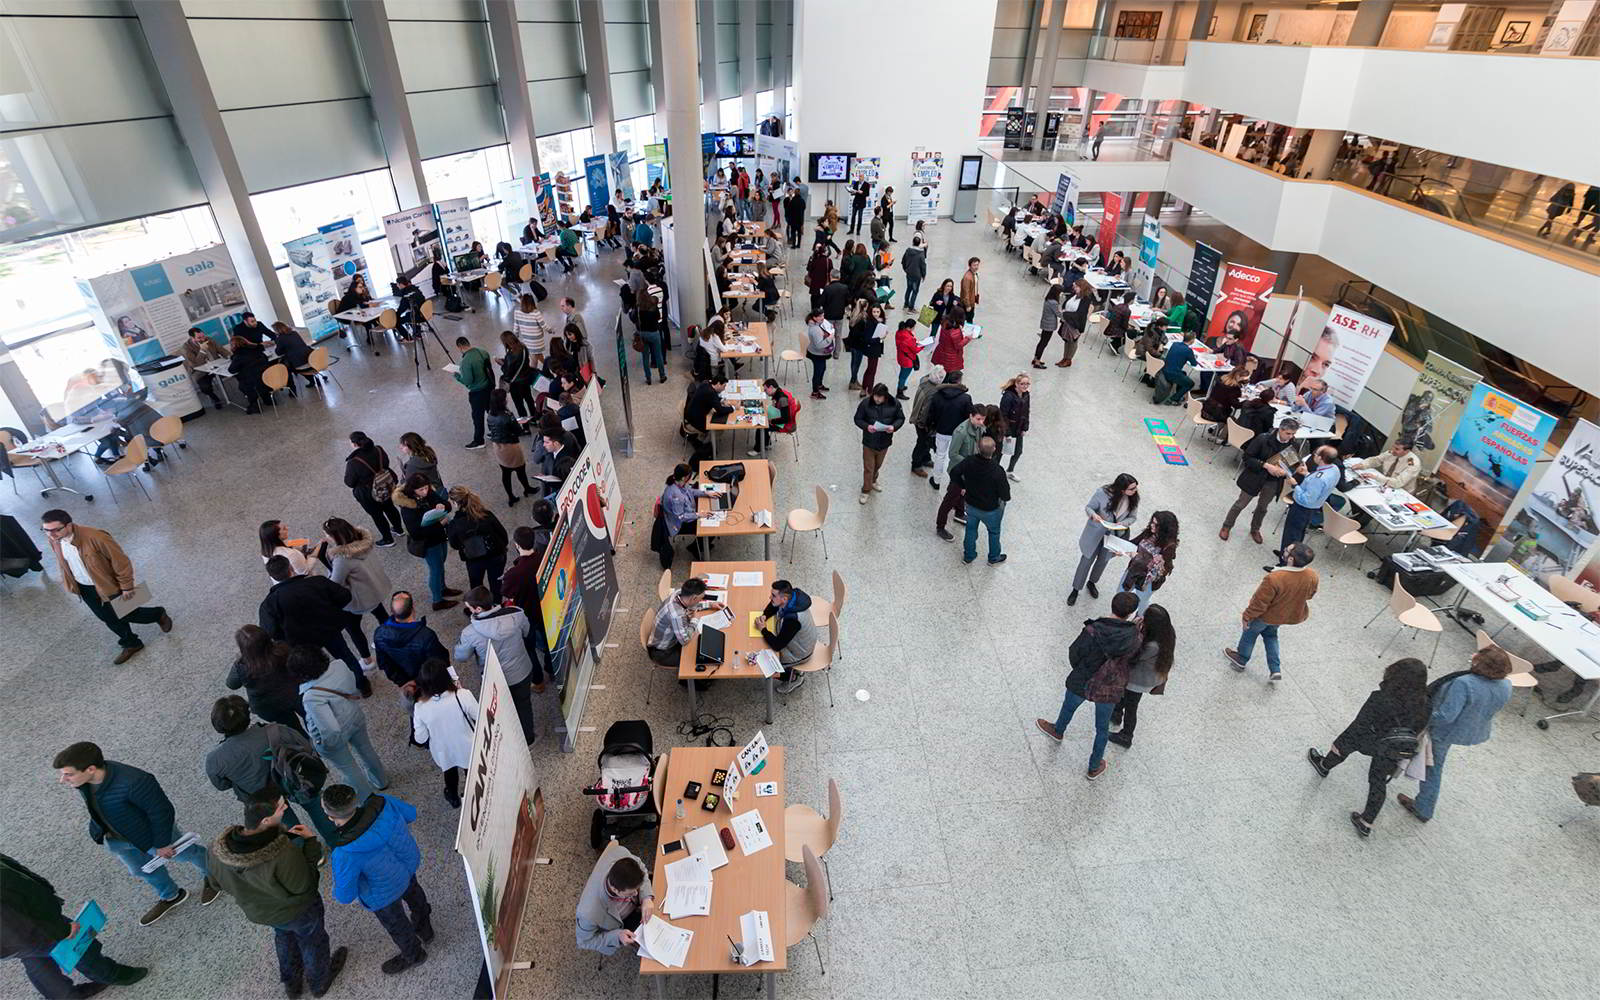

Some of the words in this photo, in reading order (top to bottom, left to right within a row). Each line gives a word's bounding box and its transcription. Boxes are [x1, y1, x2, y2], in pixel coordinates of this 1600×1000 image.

[1228, 269, 1260, 283] Adecco
[1331, 313, 1359, 331] ASE
[1361, 324, 1380, 339] RH
[1500, 422, 1541, 446] FUERZAS
[560, 463, 588, 512] PROCODE
